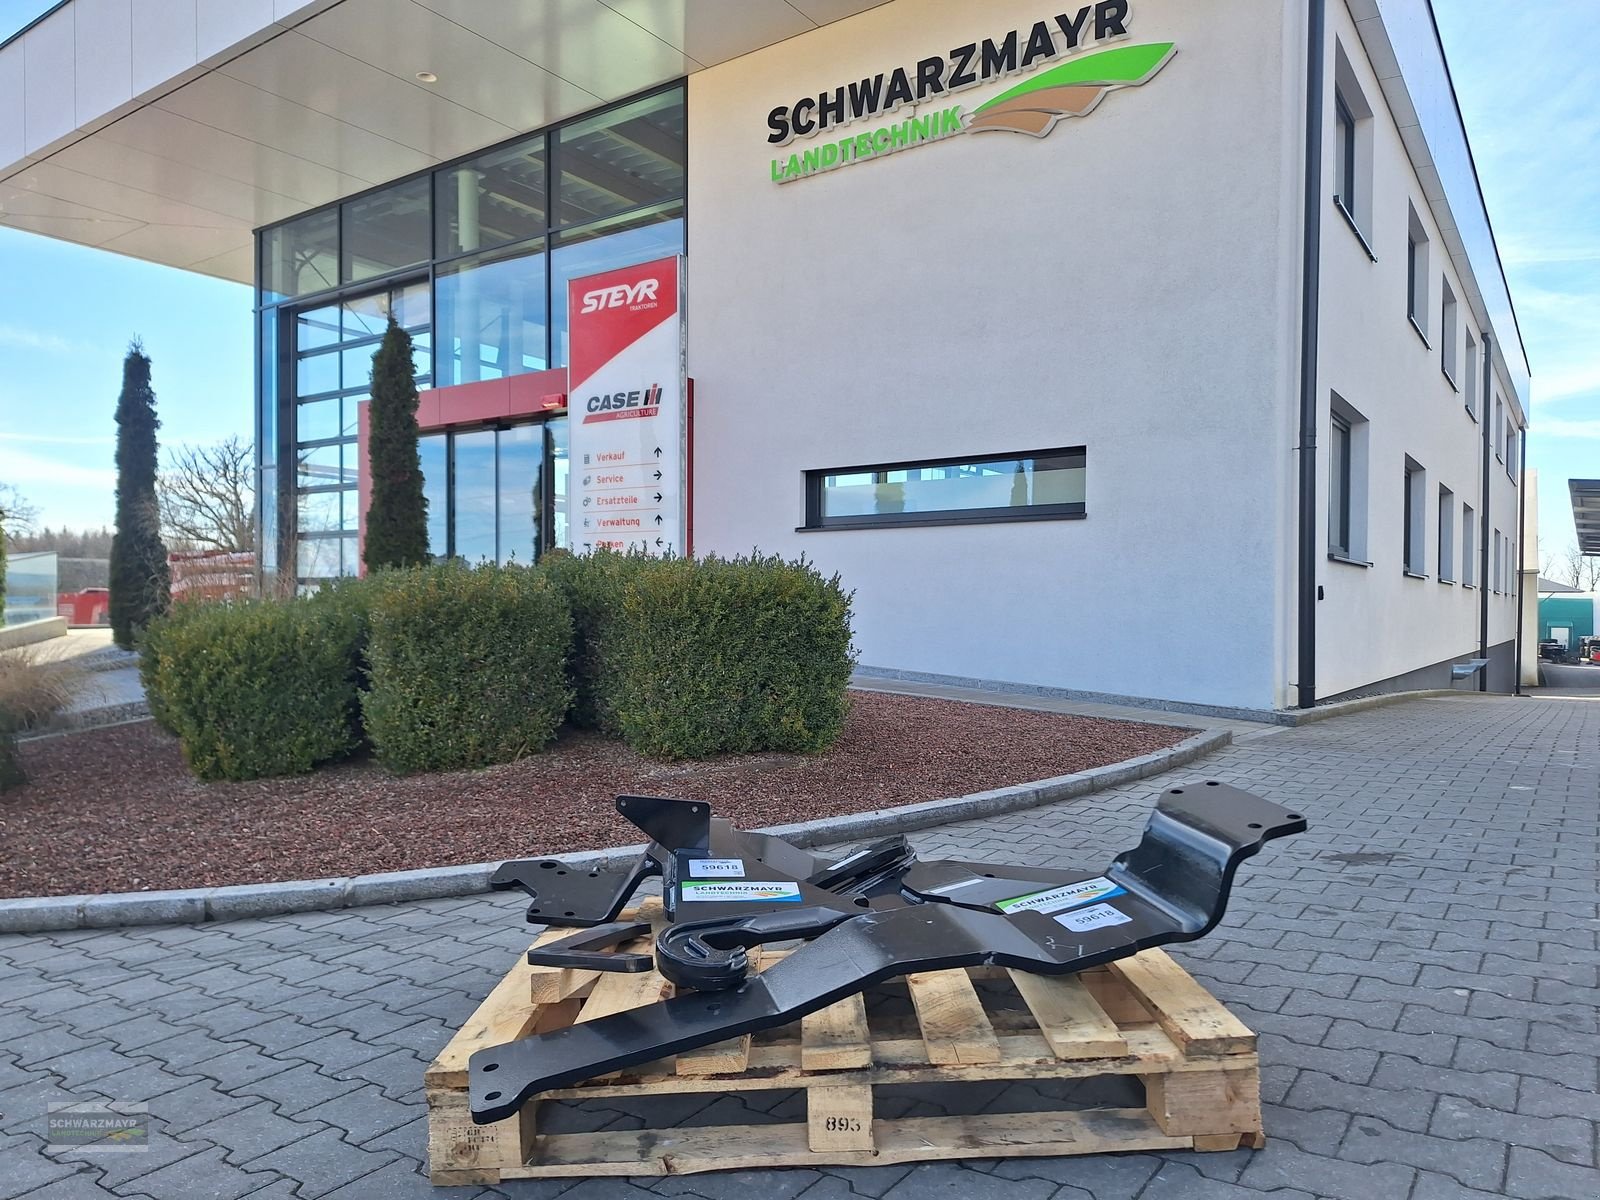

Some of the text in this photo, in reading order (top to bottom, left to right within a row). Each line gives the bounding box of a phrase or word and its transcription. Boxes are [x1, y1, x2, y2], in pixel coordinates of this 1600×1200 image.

[767, 0, 1129, 143] SCHWARZMAYR
[771, 105, 963, 182] LANDTECHNIK
[580, 278, 659, 314] STEYR
[629, 302, 658, 312] TRAKTOREN
[587, 391, 640, 413] CASE
[615, 409, 657, 419] AGRICULTURE
[597, 451, 625, 462] Verkauf
[597, 474, 624, 484] Service
[597, 495, 638, 506] Ersatzteile
[597, 517, 640, 528] Verwaltung
[597, 540, 624, 549] Pken
[1013, 884, 1099, 909] SCHWARZMAYR
[1075, 909, 1116, 925] 59618
